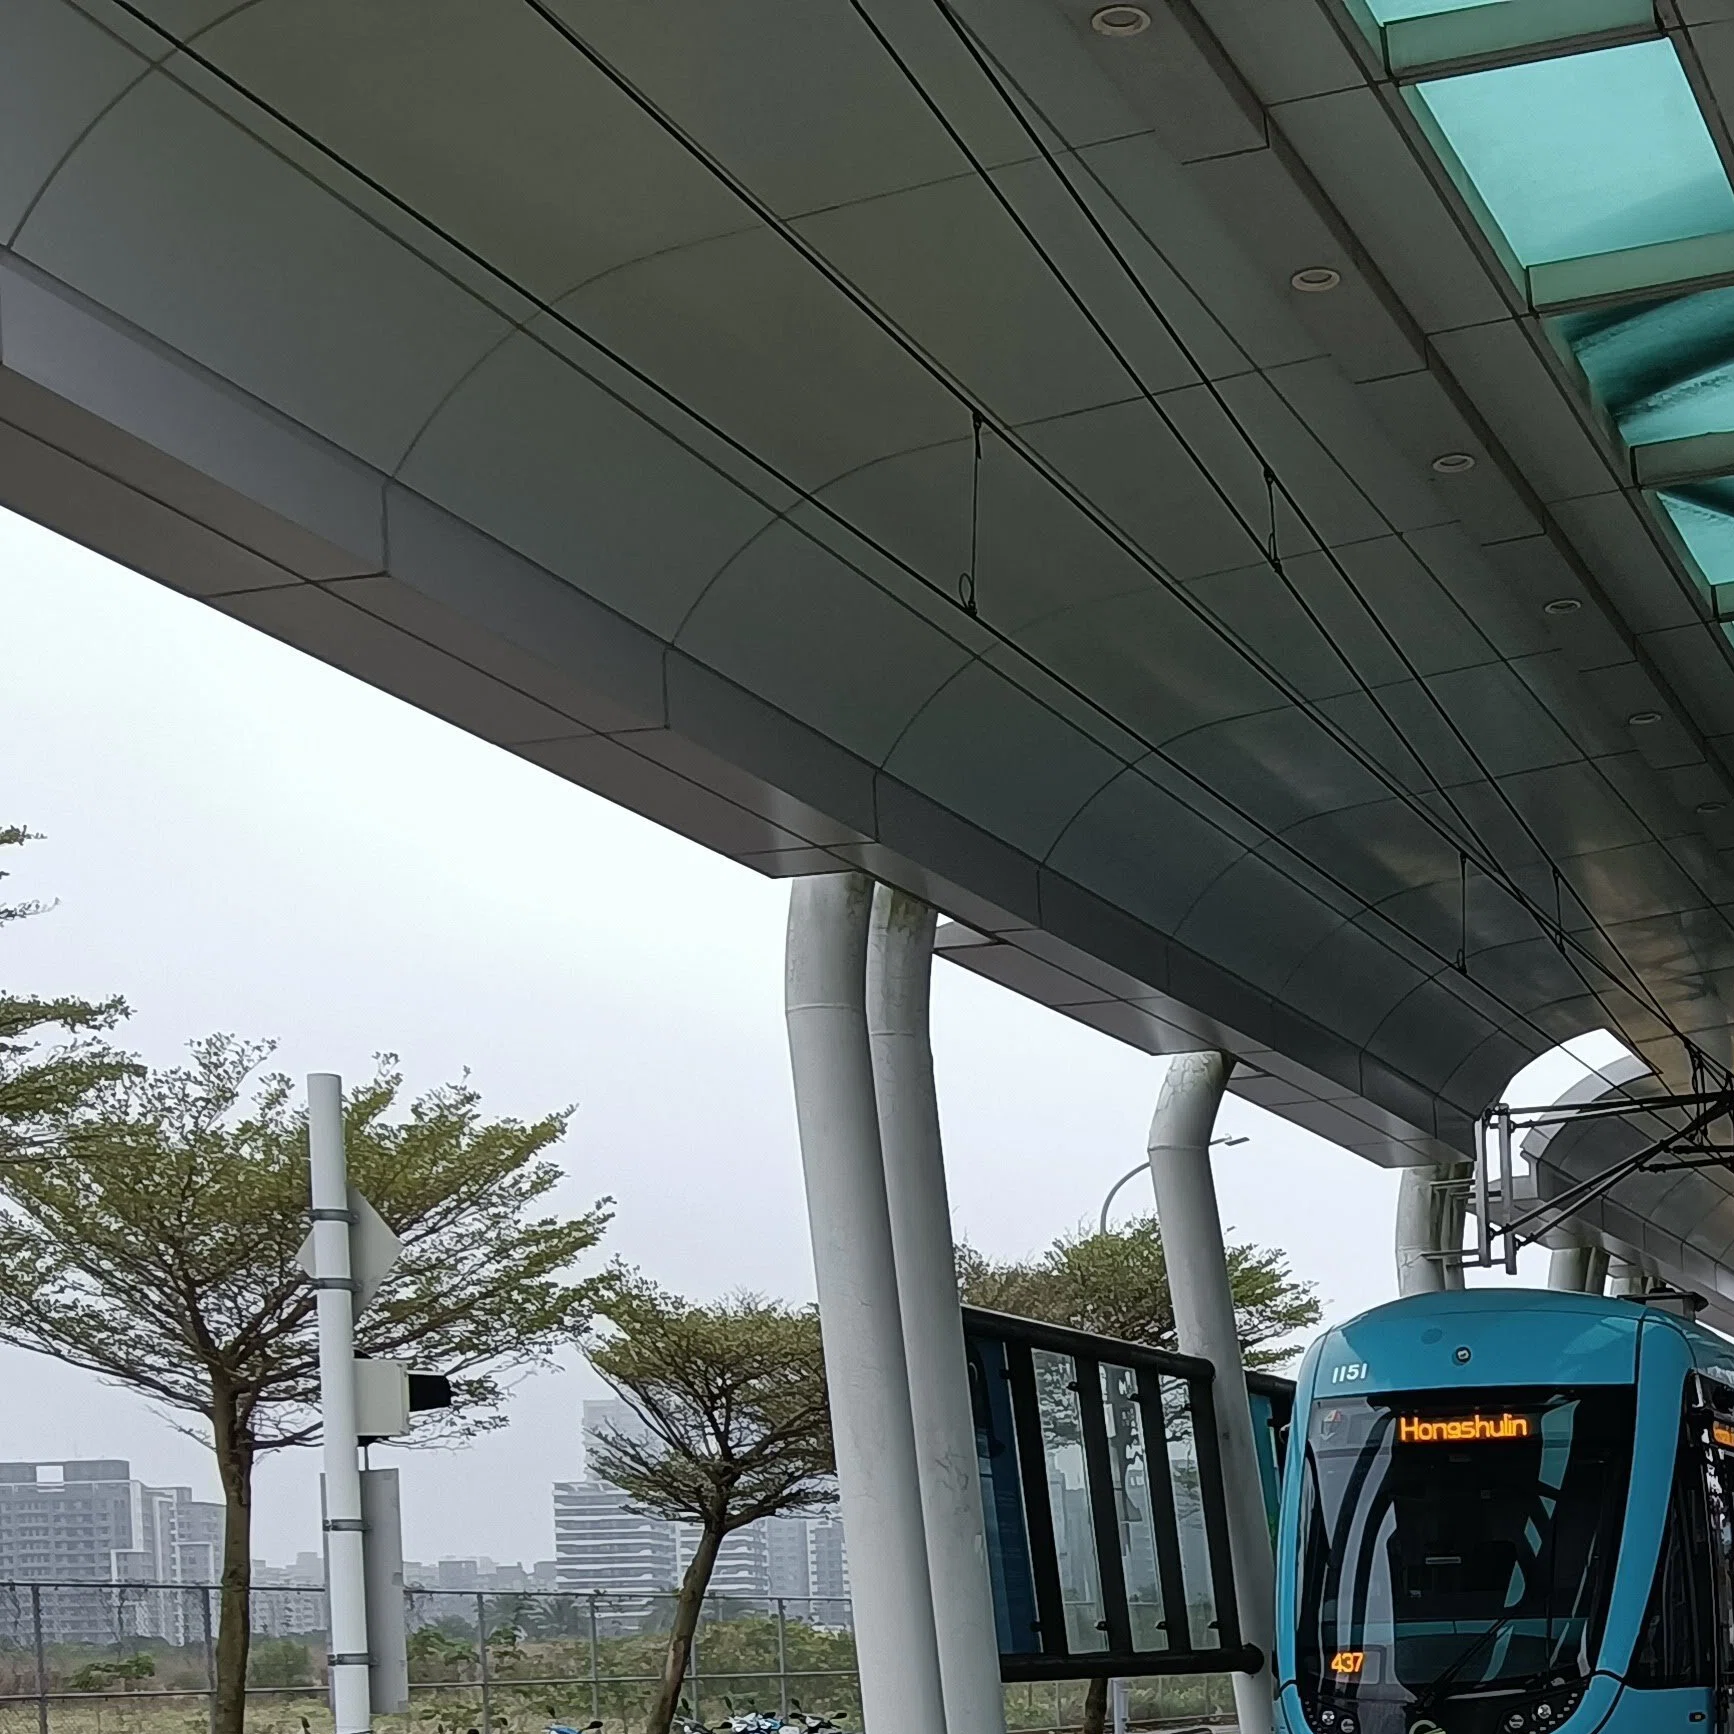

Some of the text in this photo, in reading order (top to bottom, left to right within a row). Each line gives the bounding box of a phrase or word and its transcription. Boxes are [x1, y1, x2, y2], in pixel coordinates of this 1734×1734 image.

[1332, 1362, 1368, 1384] 1151
[1400, 1413, 1527, 1441] Hongshulin
[1331, 1652, 1364, 1673] 437
